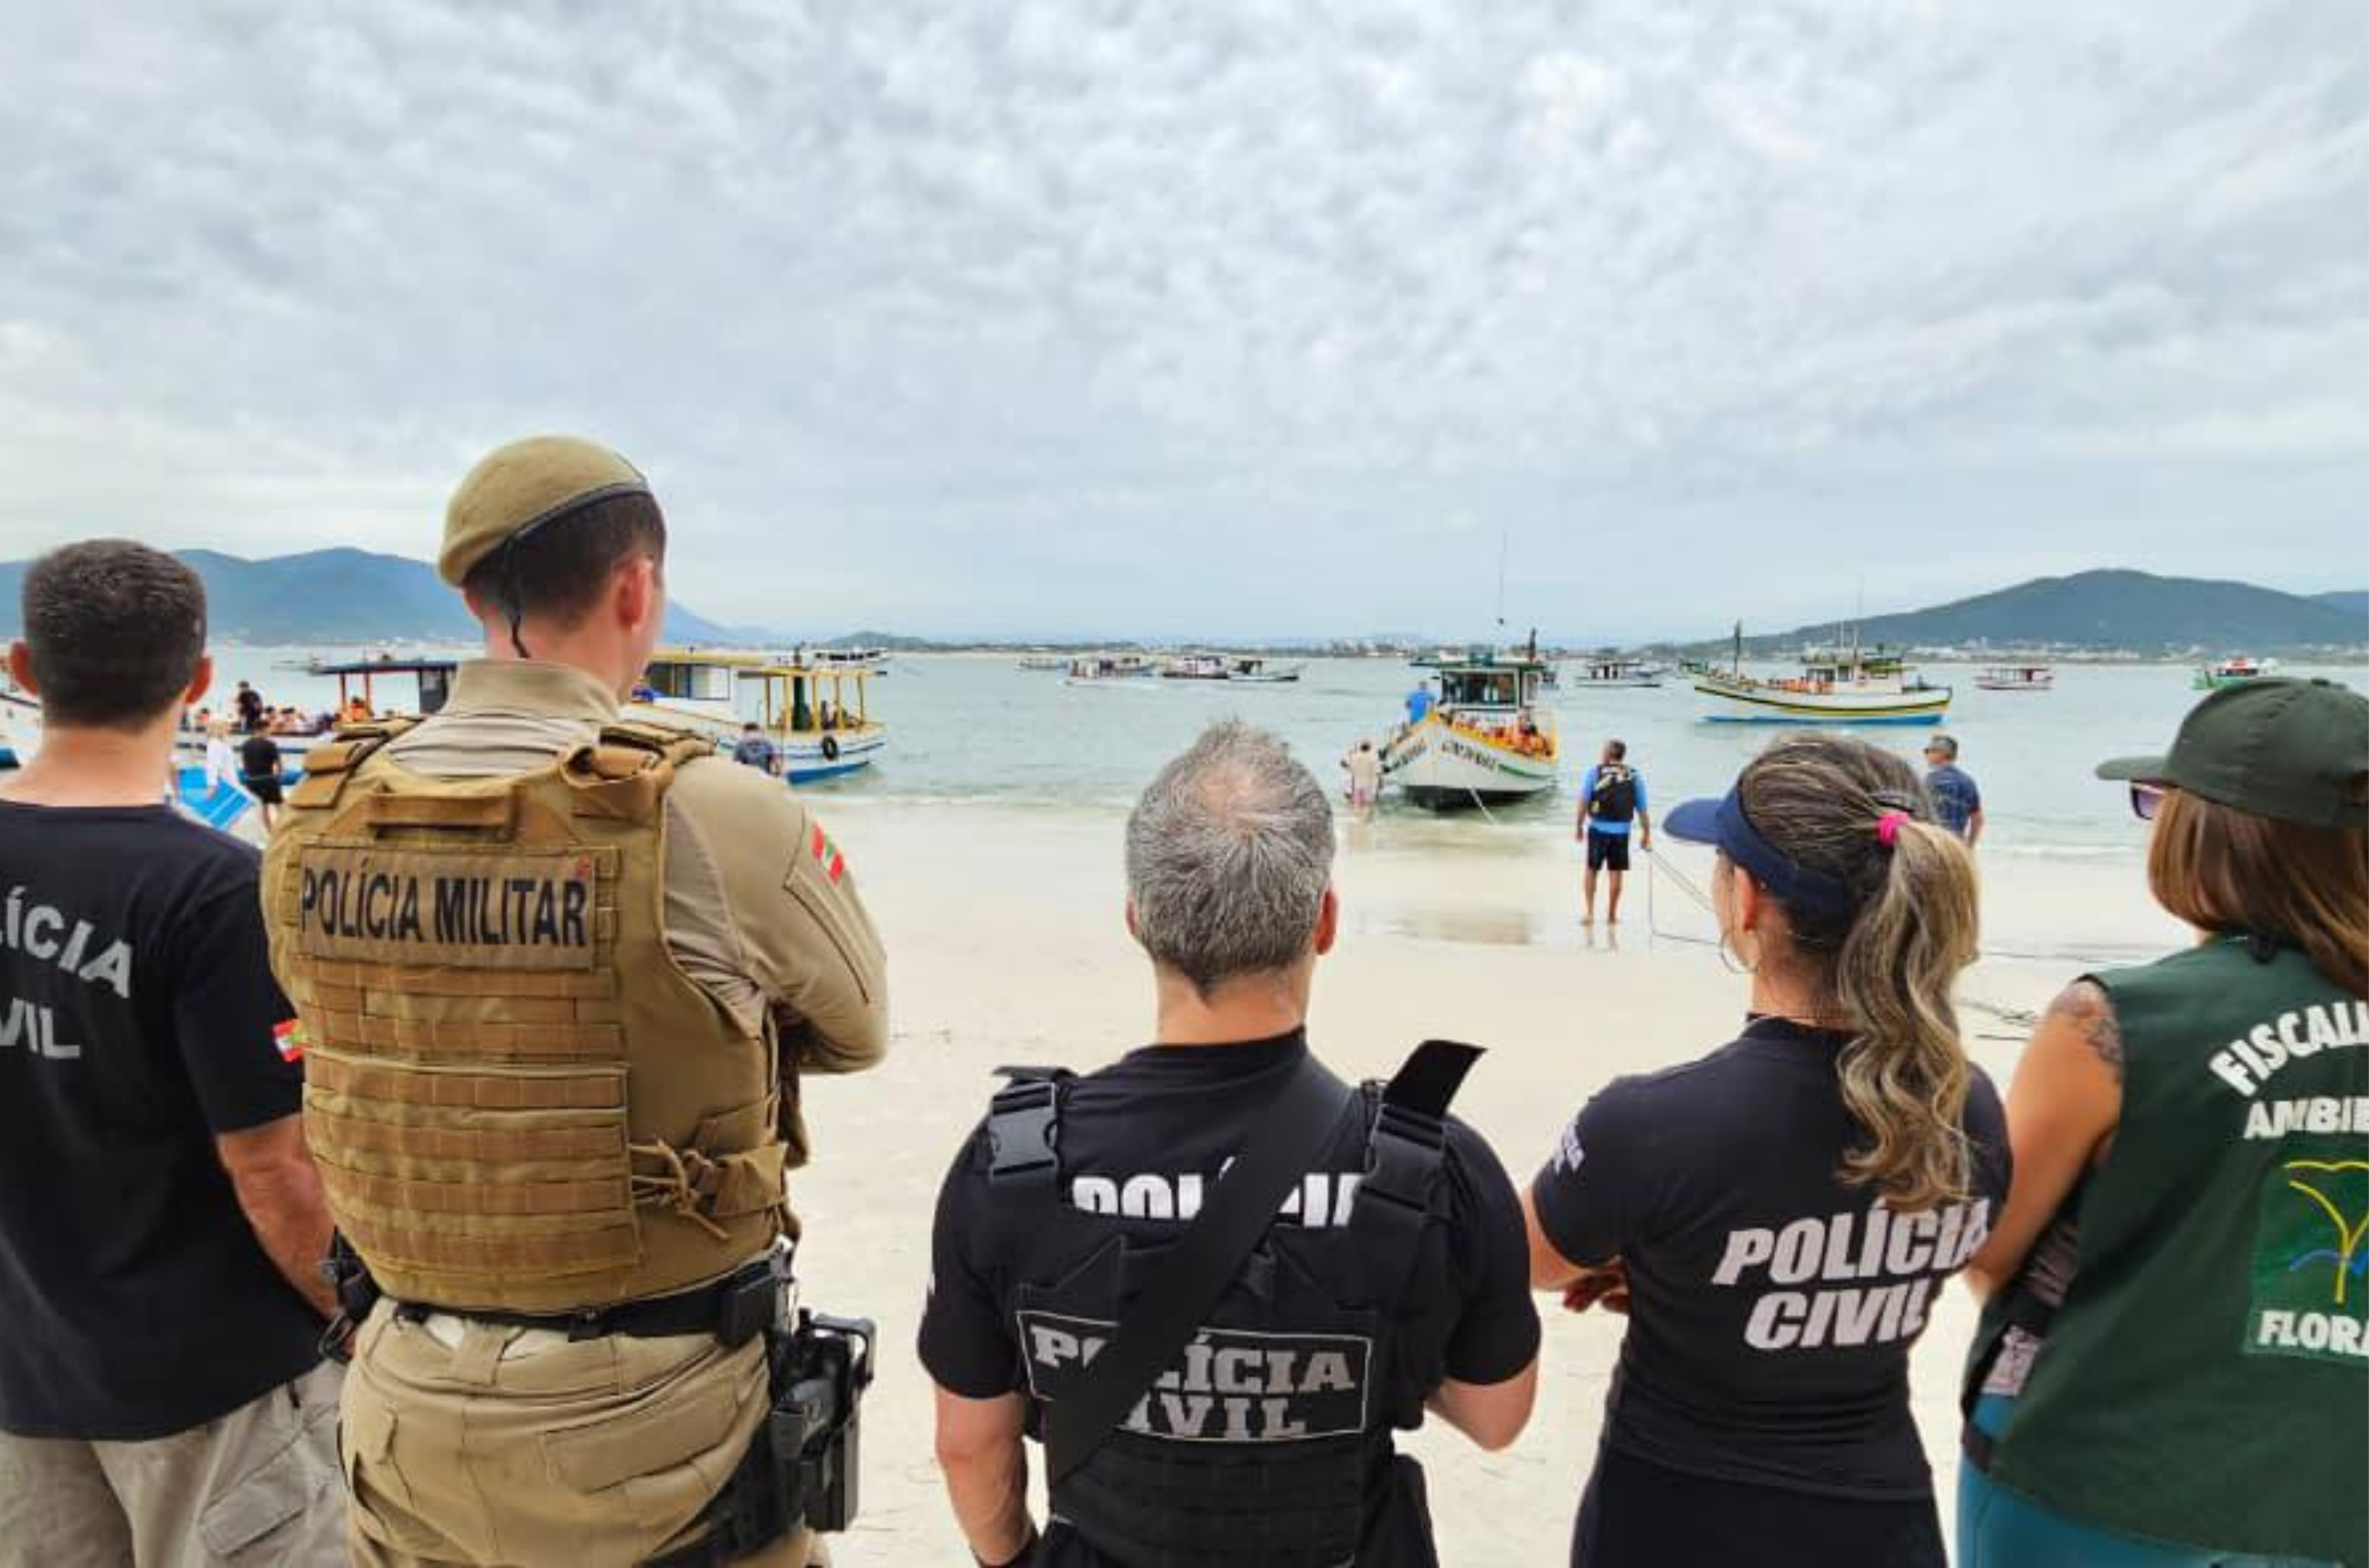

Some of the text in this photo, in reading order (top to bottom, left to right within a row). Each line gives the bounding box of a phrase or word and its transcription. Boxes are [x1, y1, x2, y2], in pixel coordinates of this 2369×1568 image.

[302, 858, 586, 946] POLÍCIA MILITAR
[0, 885, 132, 998] ÍCIA
[1744, 1279, 1931, 1349] CIVIL
[2257, 1310, 2369, 1355] FLOR
[1030, 1325, 1355, 1393] PÍCIA
